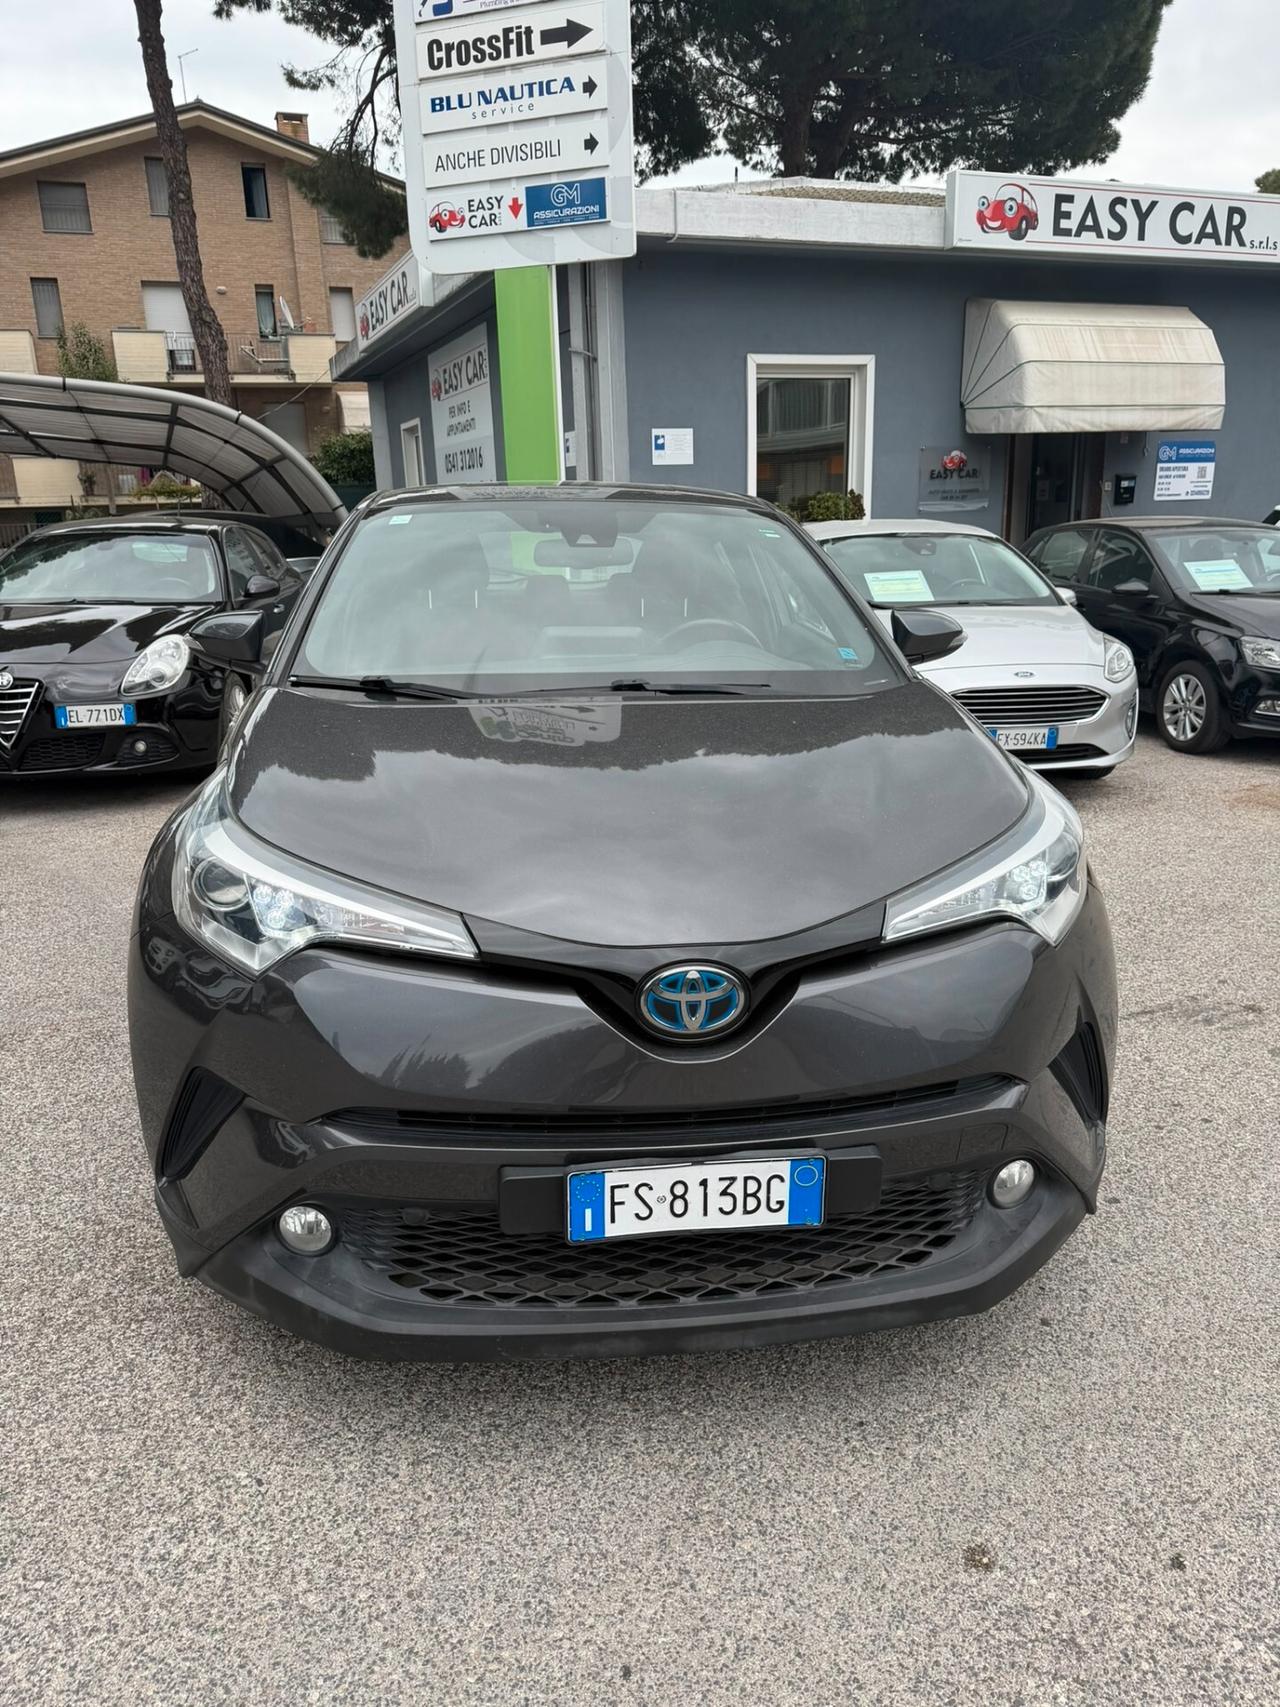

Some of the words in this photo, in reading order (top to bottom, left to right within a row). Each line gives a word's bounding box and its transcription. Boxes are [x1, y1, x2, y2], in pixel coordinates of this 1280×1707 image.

[427, 25, 535, 71] CrossFit
[430, 92, 472, 113] BLU
[477, 76, 576, 107] NAUTICA
[472, 102, 535, 120] service
[435, 149, 486, 173] ANCHE
[490, 139, 561, 166] DIVISIBILI
[468, 195, 504, 213] EASY
[551, 183, 580, 206] GM
[469, 213, 499, 229] CAR
[533, 204, 600, 220] ASSICURAZIONI
[1052, 193, 1159, 242] EASY
[1168, 201, 1247, 248] CAR
[369, 286, 389, 332] EASY
[390, 270, 409, 316] CAR
[442, 359, 463, 395] EASY
[465, 350, 486, 386] CAR
[459, 445, 484, 472] 312016
[929, 468, 955, 480] EASY
[958, 468, 978, 480] CAR
[67, 709, 84, 724] EL
[87, 707, 125, 723] 771DX
[1013, 732, 1047, 747] 594KA
[609, 1183, 654, 1225] FS
[668, 1174, 786, 1218] 813BG
